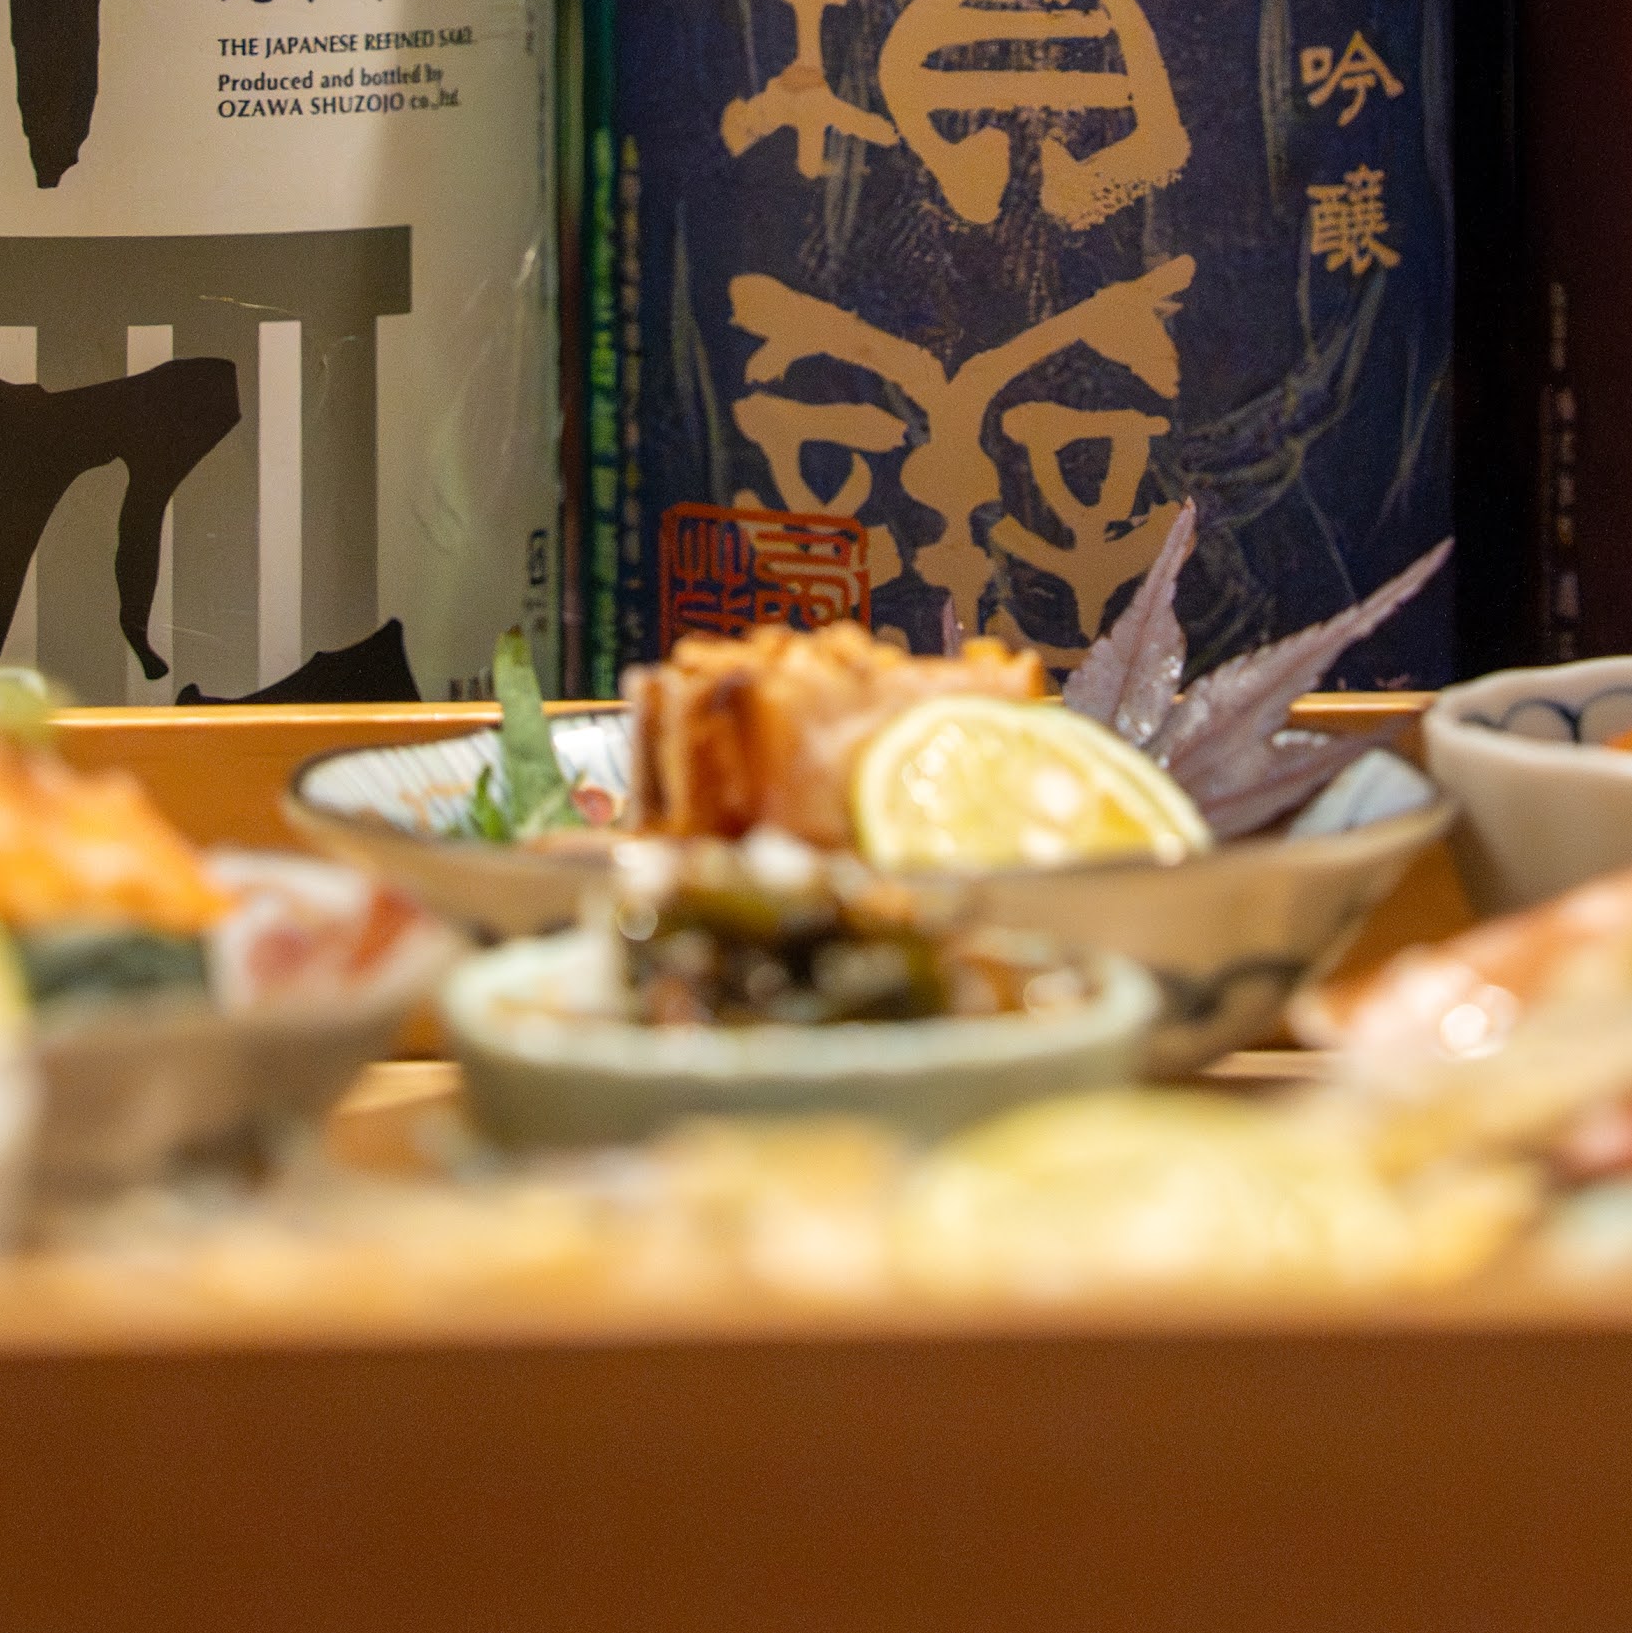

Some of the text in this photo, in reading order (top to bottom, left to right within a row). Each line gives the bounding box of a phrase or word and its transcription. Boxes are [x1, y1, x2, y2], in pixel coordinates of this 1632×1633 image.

[218, 37, 259, 56] THE
[264, 35, 358, 58] JAPANESE
[365, 29, 435, 51] REFINED
[218, 70, 314, 92] Produced
[320, 67, 354, 89] and
[360, 65, 421, 87] bottled
[218, 98, 304, 118] OZAWA
[310, 91, 405, 117] SHUZOJO
